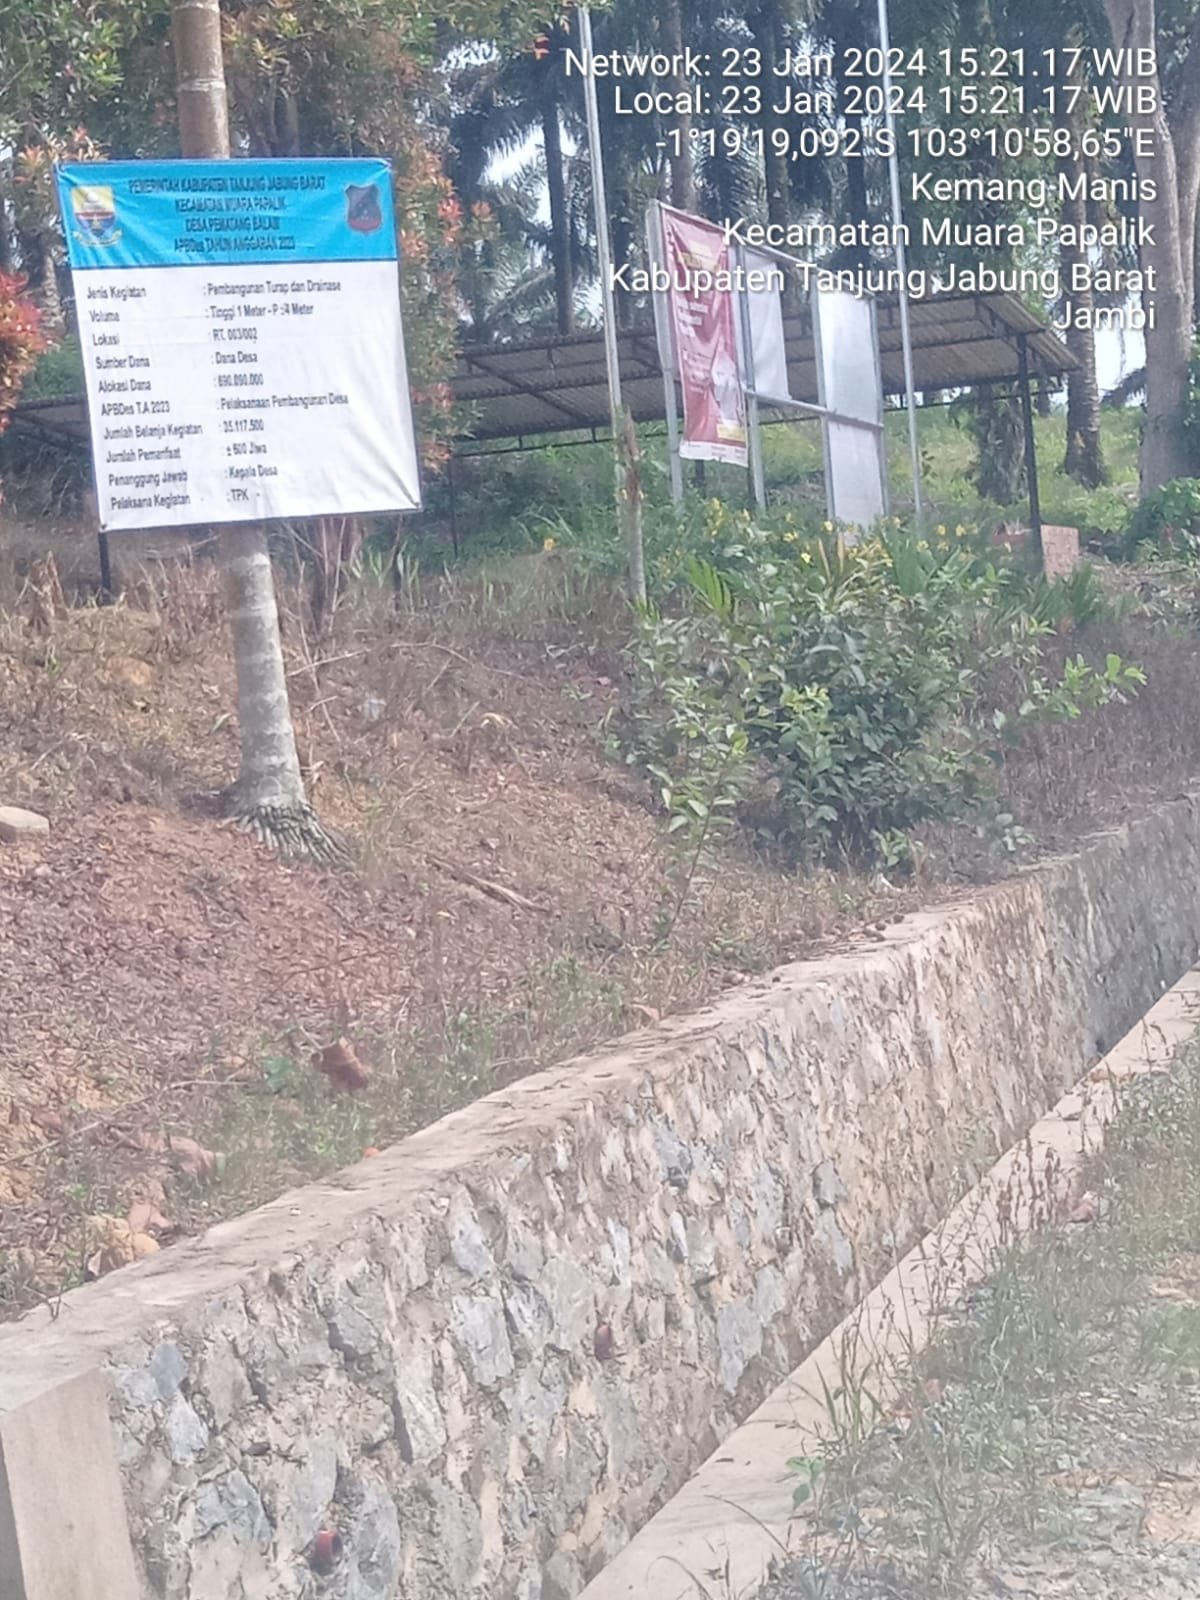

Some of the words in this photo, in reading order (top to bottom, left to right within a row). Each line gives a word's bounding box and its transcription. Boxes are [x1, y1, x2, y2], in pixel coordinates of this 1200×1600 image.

[300, 176, 326, 189] BARAT
[186, 219, 208, 232] DESA
[205, 238, 231, 251] TAHUN
[87, 286, 108, 299] Jenis
[110, 286, 146, 301] Kegiatan
[208, 282, 264, 298] Pembangunan
[266, 281, 289, 297] Turap
[290, 281, 306, 293] dan
[307, 280, 341, 292] Drainase
[89, 310, 120, 322] Volume
[210, 305, 235, 321] Tinggi
[243, 305, 266, 317] Meter
[292, 303, 314, 315] Meter
[92, 334, 120, 346] Lokasi
[96, 356, 127, 369] Sumber
[129, 355, 150, 368] Dana
[215, 352, 236, 364] Dana
[237, 351, 258, 363] Desa
[98, 380, 128, 393] Alokasi
[130, 379, 151, 391] Dana
[151, 400, 170, 413] 2023
[220, 396, 271, 411] Pelaksanaan
[272, 395, 327, 410] Pembangunan
[329, 394, 349, 405] Desa
[104, 427, 134, 440] Jumlah
[136, 425, 166, 440] Belanja
[167, 423, 203, 439] Kegiatan
[106, 450, 136, 463] Jumlah
[137, 447, 181, 461] Pemanfaat
[249, 442, 267, 454] Jiwa
[108, 473, 160, 487] Penanggung
[162, 470, 188, 482] Jawab
[229, 466, 256, 480] Kepala
[258, 464, 277, 477] Desa
[111, 496, 153, 511] Pelaksana
[154, 493, 190, 508] Kegiatan
[231, 488, 249, 502] TPK
